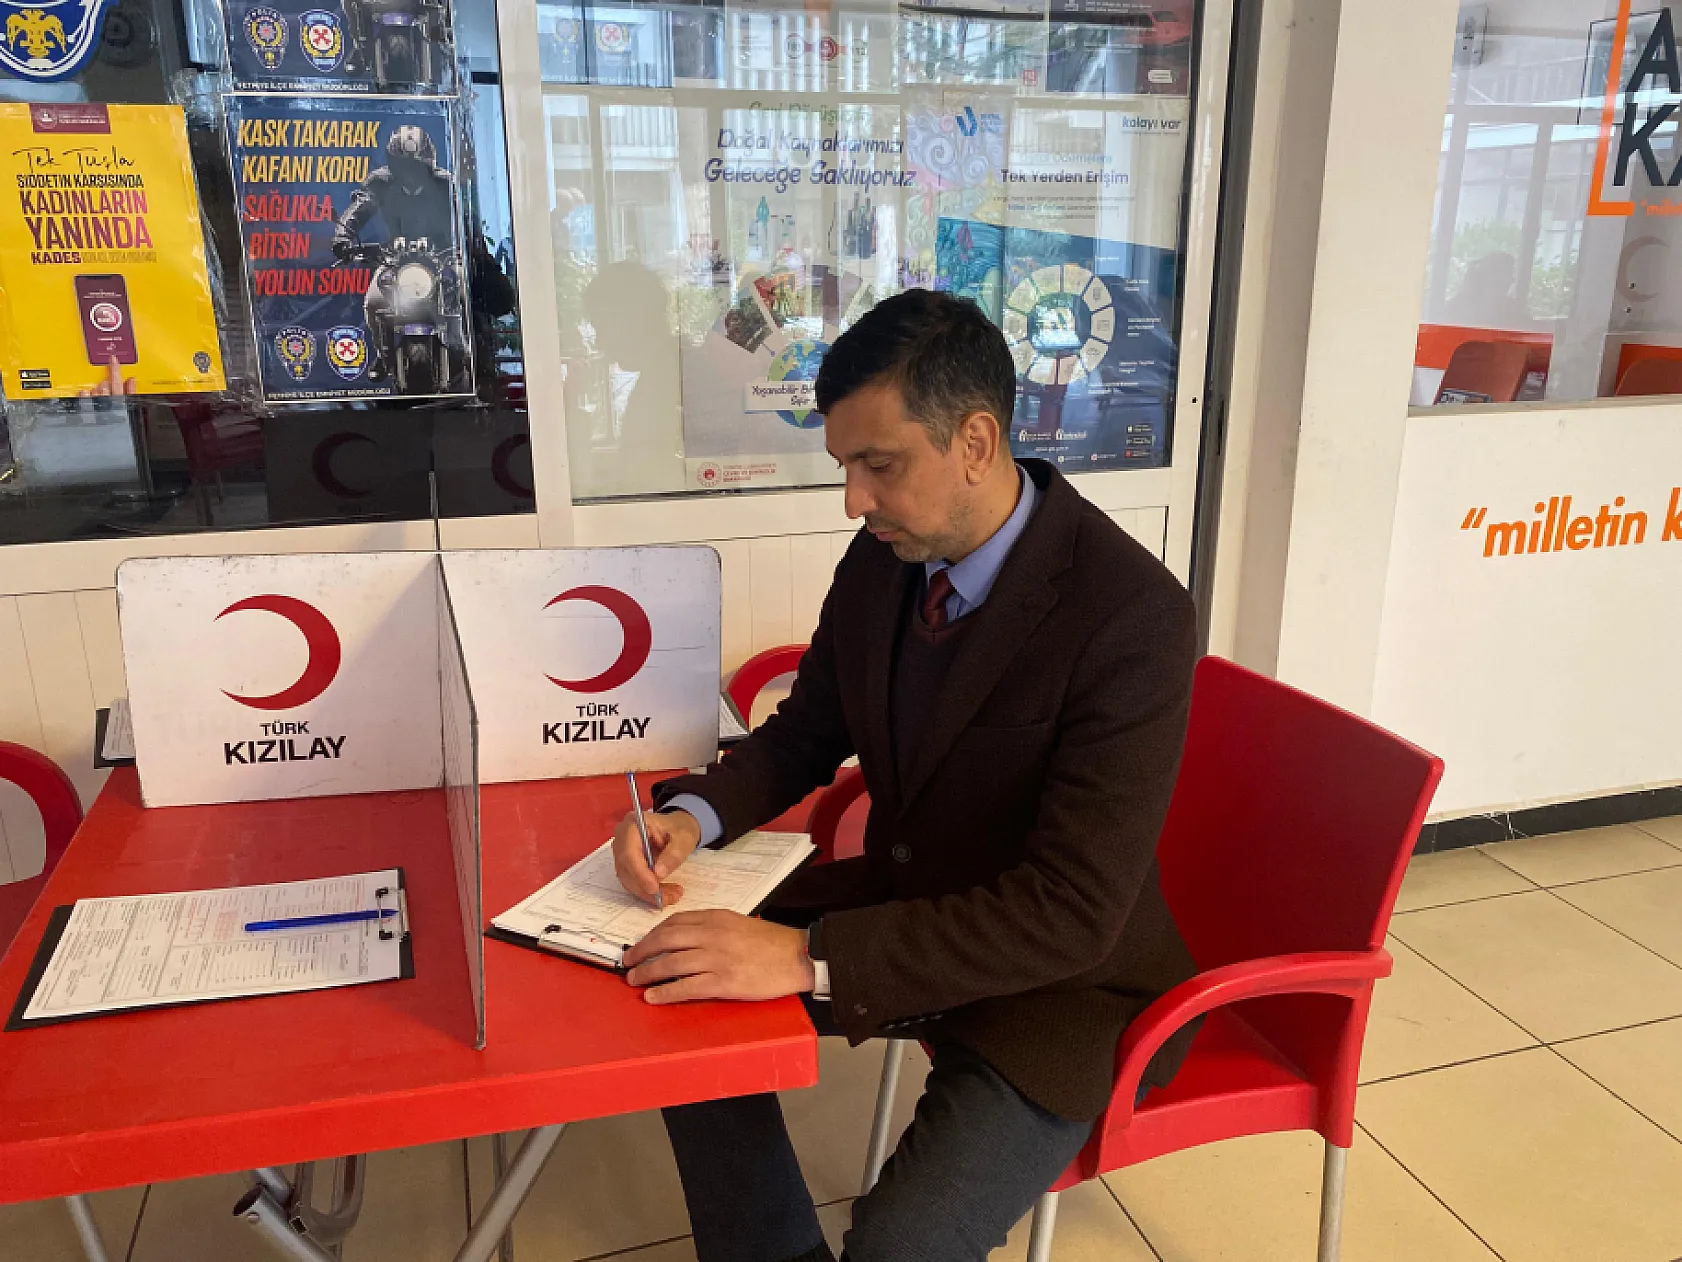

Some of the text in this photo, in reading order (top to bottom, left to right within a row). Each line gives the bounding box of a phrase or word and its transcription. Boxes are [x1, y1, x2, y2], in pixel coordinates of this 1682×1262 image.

[237, 119, 381, 148] KASK TAKARAK
[1613, 103, 1682, 187] K
[242, 155, 369, 183] KAFANI KORU
[704, 157, 800, 194] Geleceğe
[20, 189, 148, 214] KADINLARIN
[243, 189, 333, 222] SAĞLIKLA
[24, 216, 153, 250] YANINDA
[249, 228, 310, 260] BİTSİN
[31, 251, 82, 265] KADES
[254, 268, 370, 297] YOLUN SONU
[576, 702, 620, 718] TÜRK
[259, 719, 310, 736] TÜRK
[542, 717, 652, 745] KIZILAY
[224, 735, 347, 766] KIZILAY
